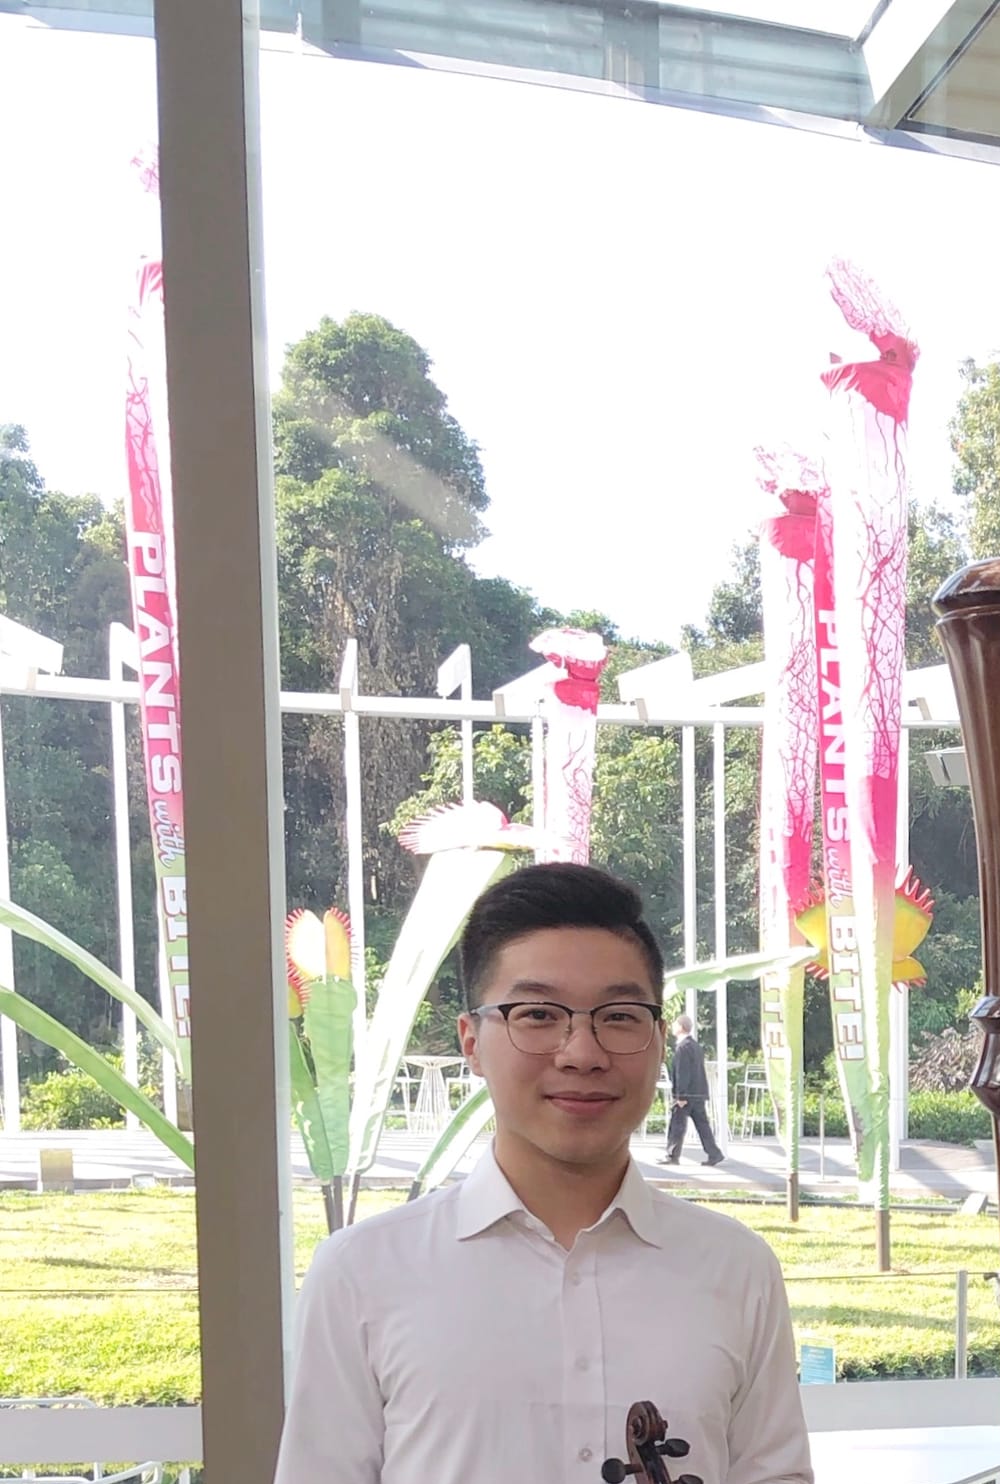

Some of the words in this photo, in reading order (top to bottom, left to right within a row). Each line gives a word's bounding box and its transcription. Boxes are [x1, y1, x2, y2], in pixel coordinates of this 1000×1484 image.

[132, 531, 181, 793] PLANTS
[818, 609, 850, 842] PLANTS
[153, 800, 185, 868] with
[827, 848, 853, 909] with
[830, 915, 864, 1060] BITE!
